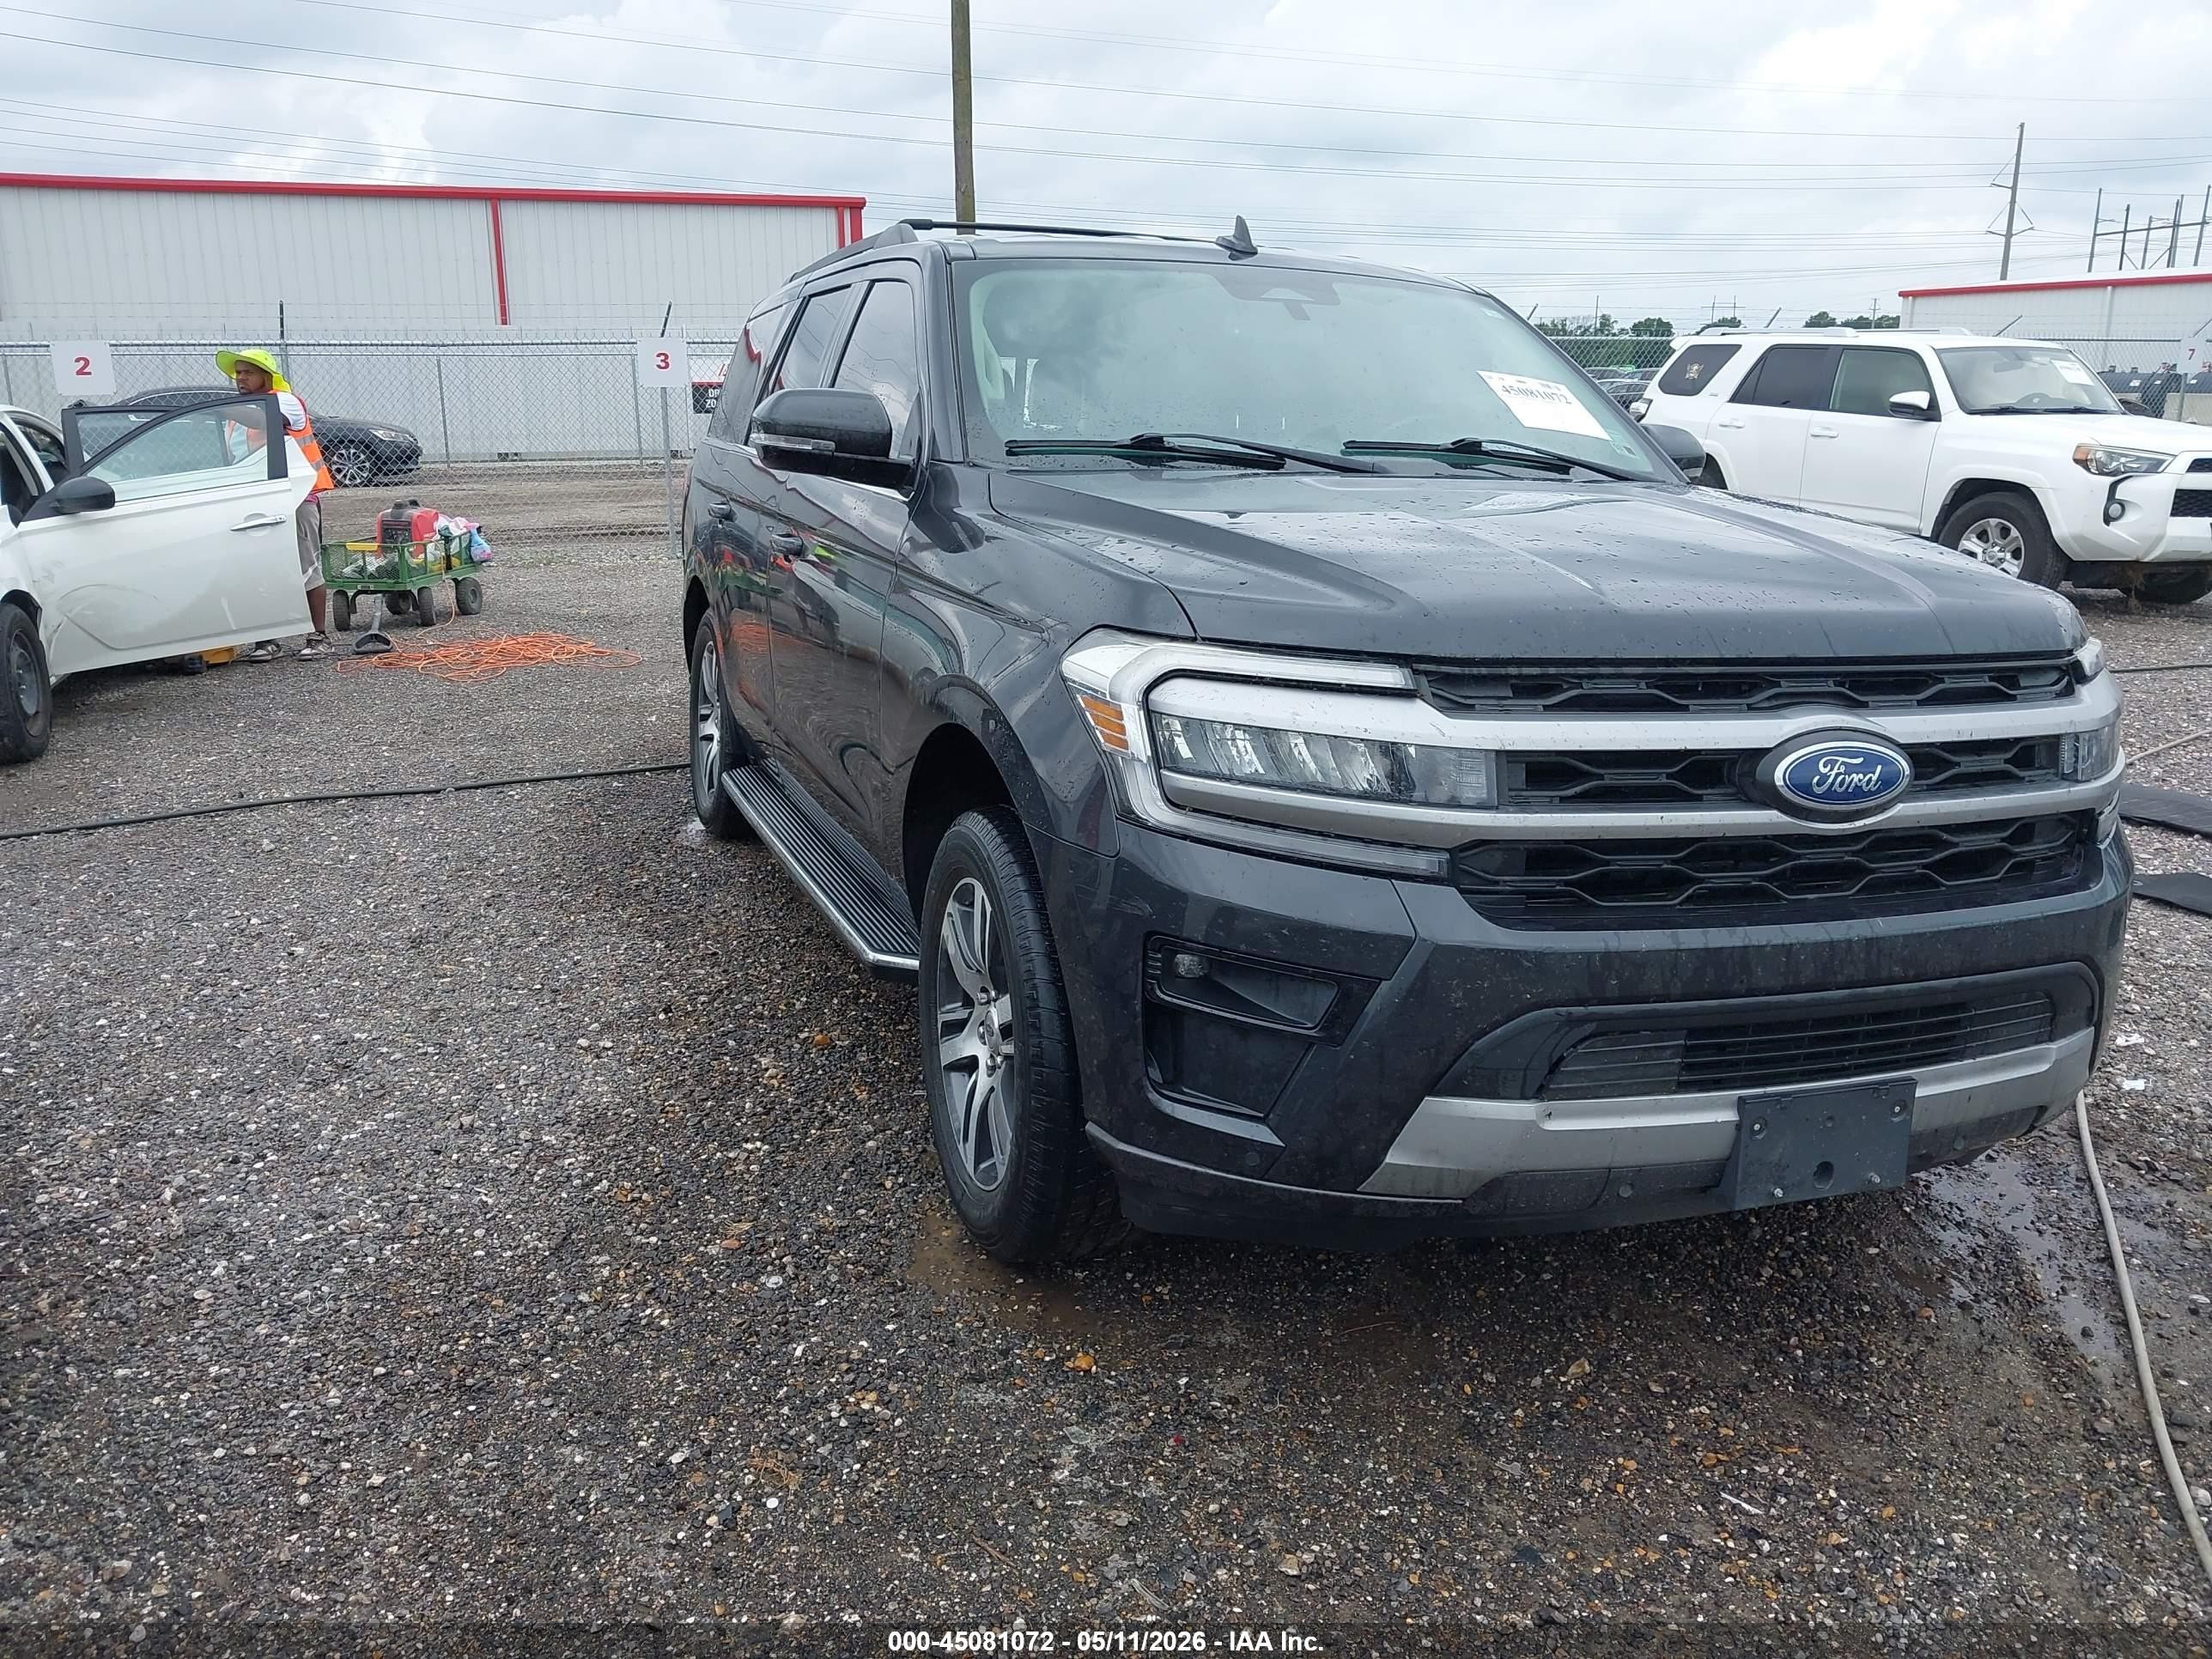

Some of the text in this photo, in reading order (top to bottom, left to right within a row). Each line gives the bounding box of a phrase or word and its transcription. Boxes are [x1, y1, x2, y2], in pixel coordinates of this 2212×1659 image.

[655, 352, 671, 370] 3
[2188, 349, 2196, 361] 7
[74, 356, 92, 376] 2
[1502, 385, 1572, 404] 45081072
[1811, 756, 1882, 794] Ford
